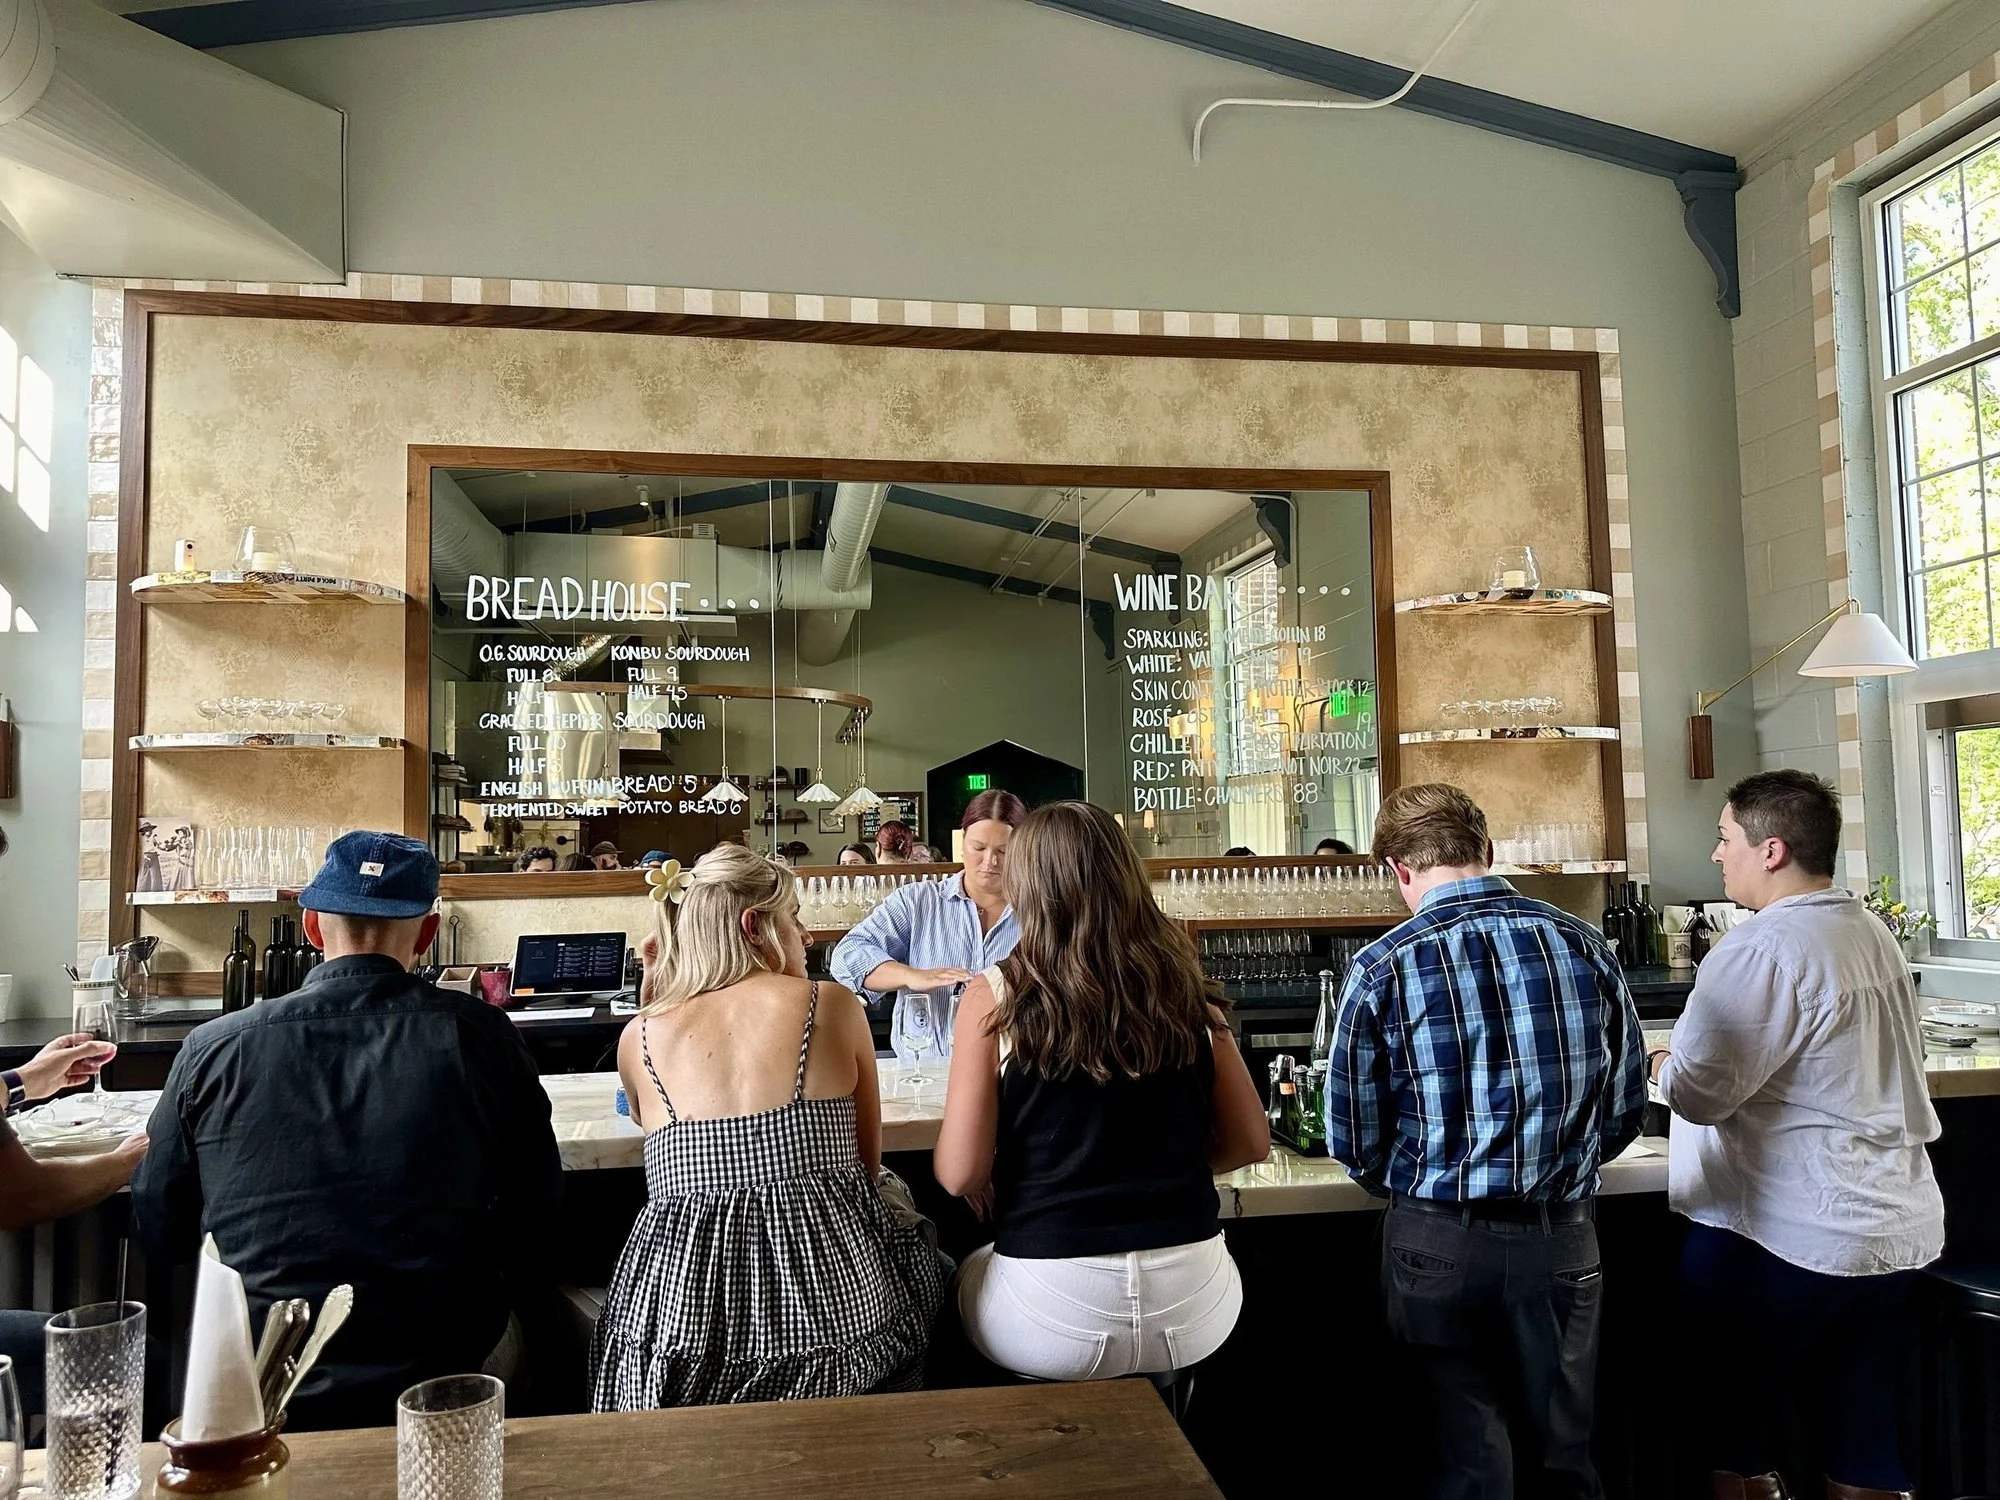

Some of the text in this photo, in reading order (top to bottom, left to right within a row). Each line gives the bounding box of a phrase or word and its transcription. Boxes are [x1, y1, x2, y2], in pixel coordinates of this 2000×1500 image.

[1113, 572, 1243, 613] WINE BAR
[1123, 628, 1209, 650] SPARKLING:
[1314, 625, 1326, 643] 18
[506, 645, 587, 662] SOURDOUGH
[610, 645, 750, 662] KONBU SOURDOUGH
[627, 666, 678, 682] FULL 9
[1126, 653, 1182, 676] WHITE:
[506, 668, 541, 684] FULL
[628, 684, 661, 701] HALF
[1130, 679, 1165, 702] SKIN
[1357, 680, 1372, 698] 12
[612, 712, 706, 732] SOURDOUGH
[1356, 711, 1372, 733] 19
[507, 736, 545, 753] FULL
[508, 757, 546, 776] HALF
[1133, 759, 1176, 782] RED:
[1309, 757, 1343, 776] NOIR
[480, 780, 542, 797] ENGLISH
[611, 775, 673, 795] BREAD
[683, 775, 697, 794] 5
[1134, 786, 1203, 813] BOTTLE:
[1293, 781, 1319, 805] 88
[480, 800, 741, 818] FERMENTED SWEET POTATO BREAD 6
